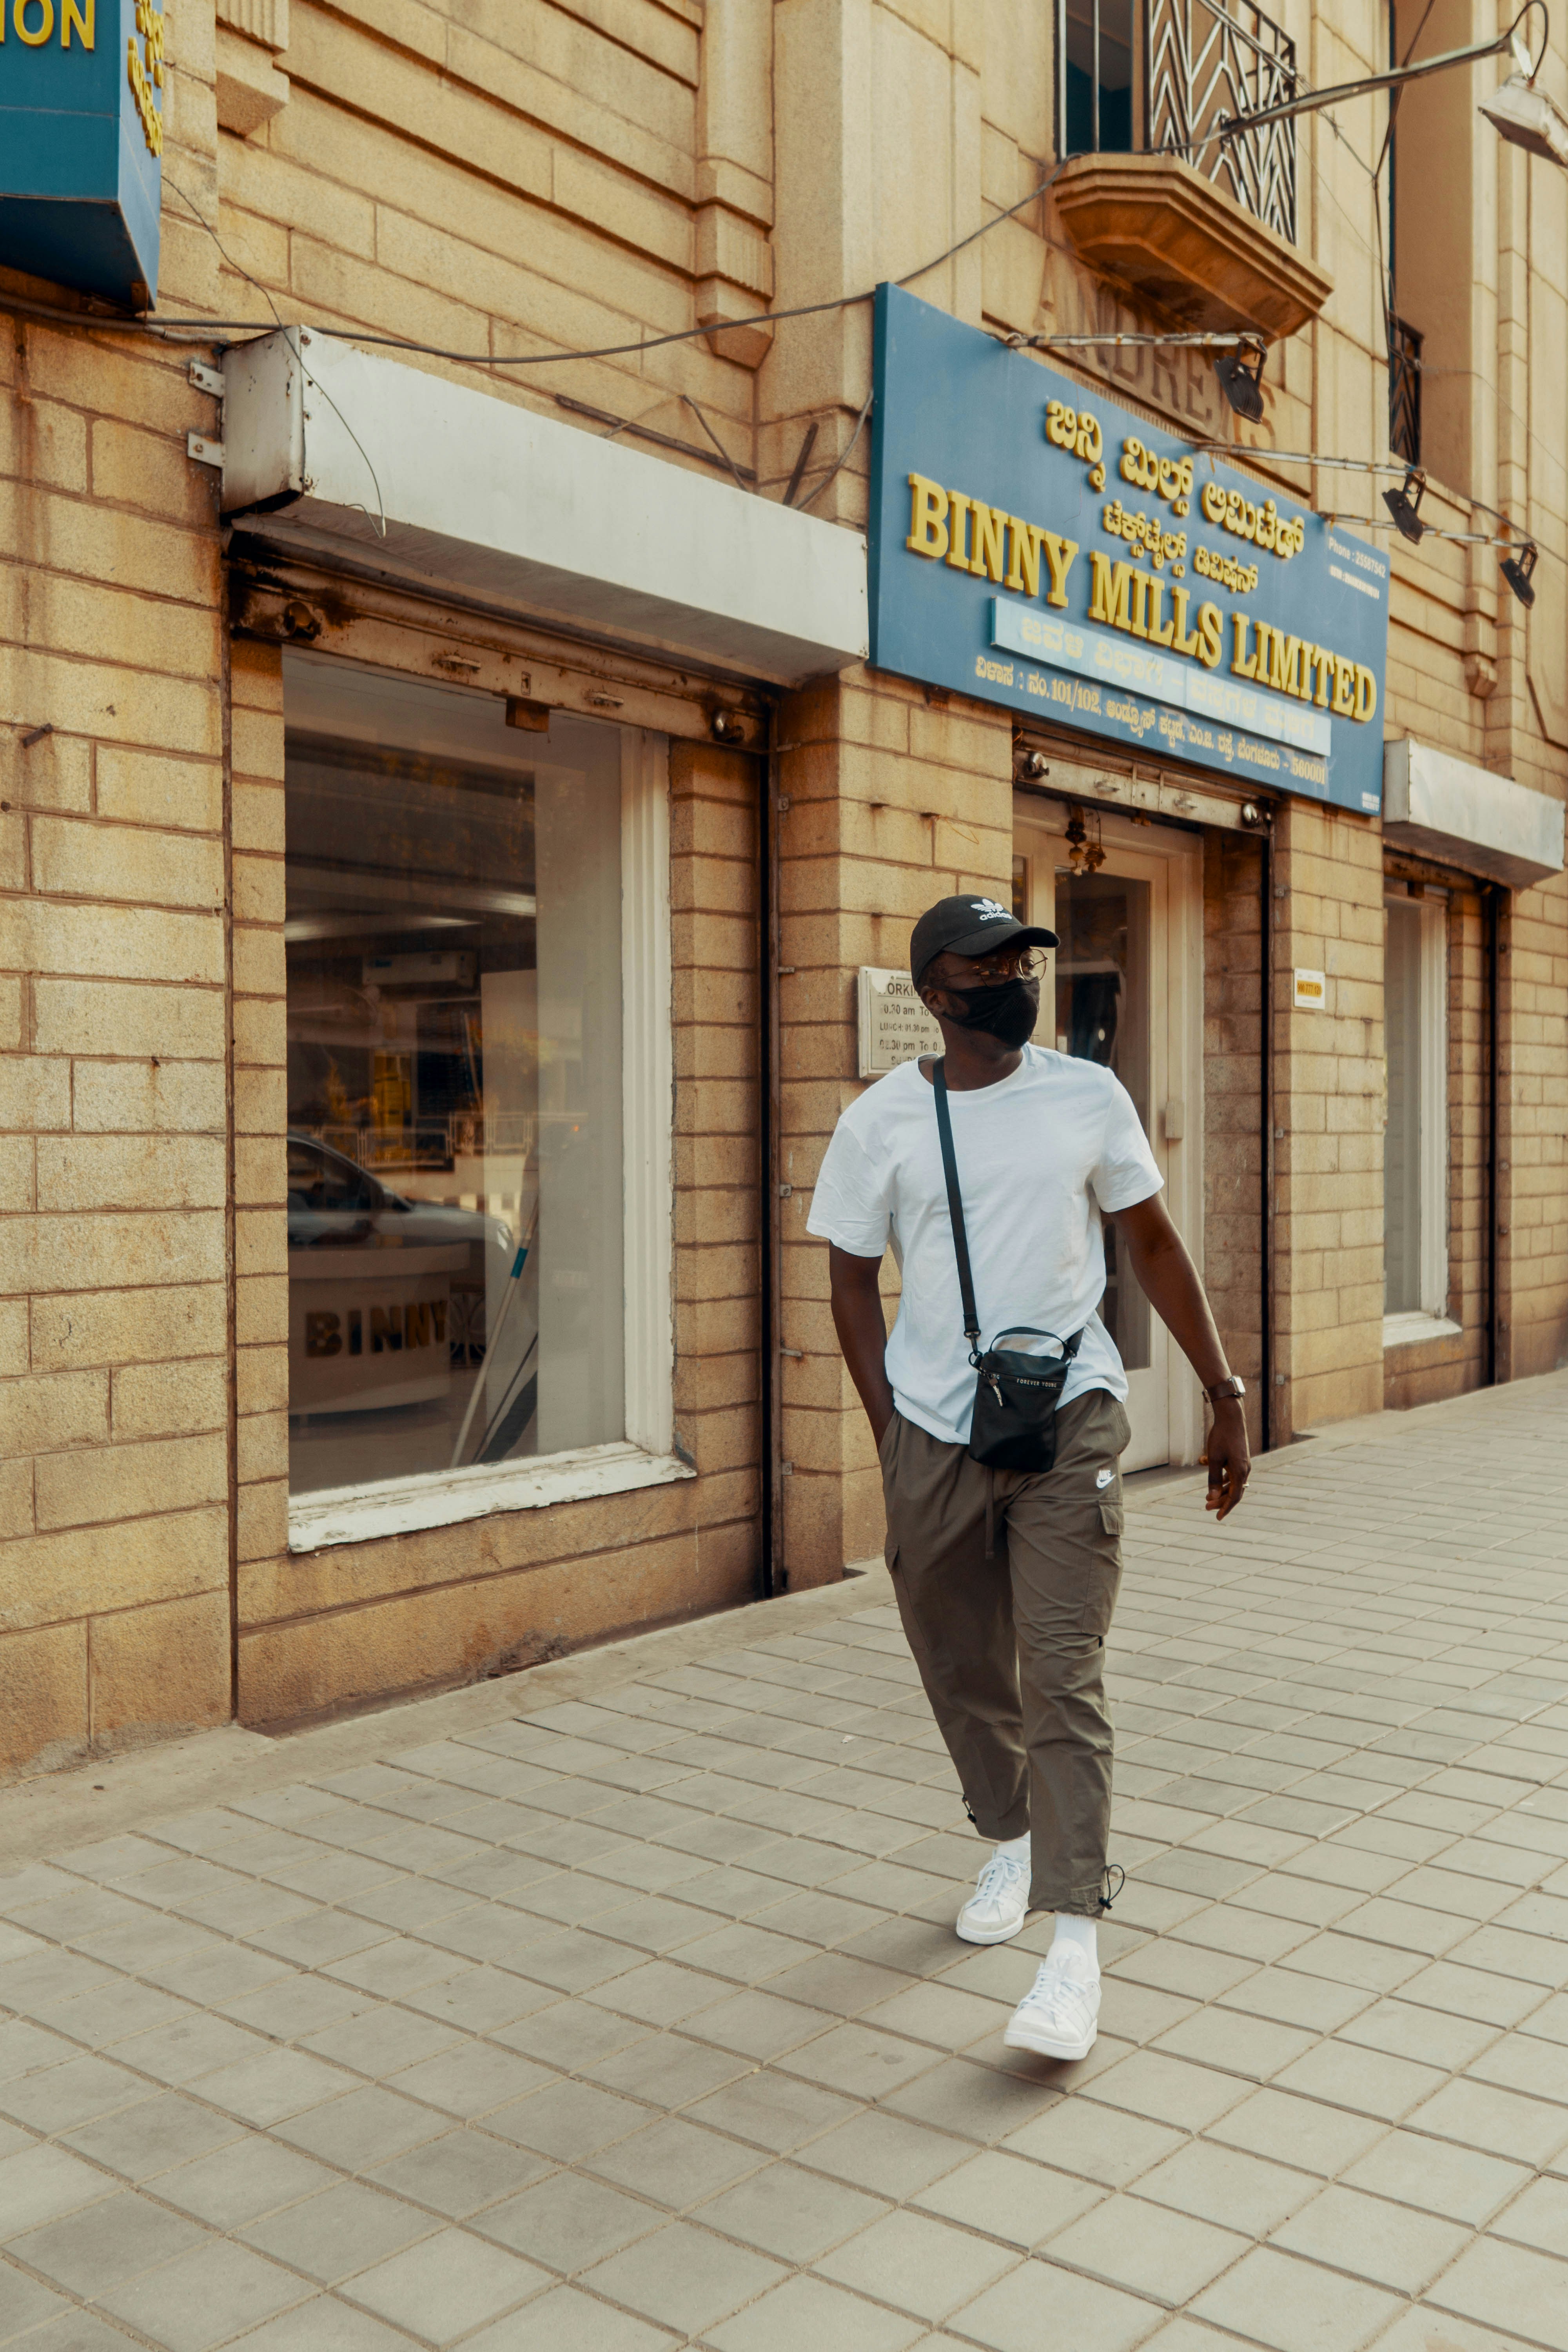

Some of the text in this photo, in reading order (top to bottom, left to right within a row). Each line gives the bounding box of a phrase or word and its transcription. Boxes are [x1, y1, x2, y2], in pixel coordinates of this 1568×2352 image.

[1046, 400, 1304, 559] ಬಿನ್ನಿ ಮಿಲ್ಸ್ ಲಿಮಿಟೆಡ್
[1328, 537, 1351, 560] Phone
[1194, 546, 1258, 593] ಡಿವಿಷನ್
[906, 473, 1377, 723] BINNY MILLS LIMITED
[976, 656, 1013, 686] ವಿಳಾಸ
[979, 911, 1013, 920] adidas
[903, 1042, 915, 1053] pm
[306, 1300, 448, 1357] BINNY
[1016, 1378, 1040, 1387] FOREVER
[1099, 1470, 1112, 1480] NIKE
